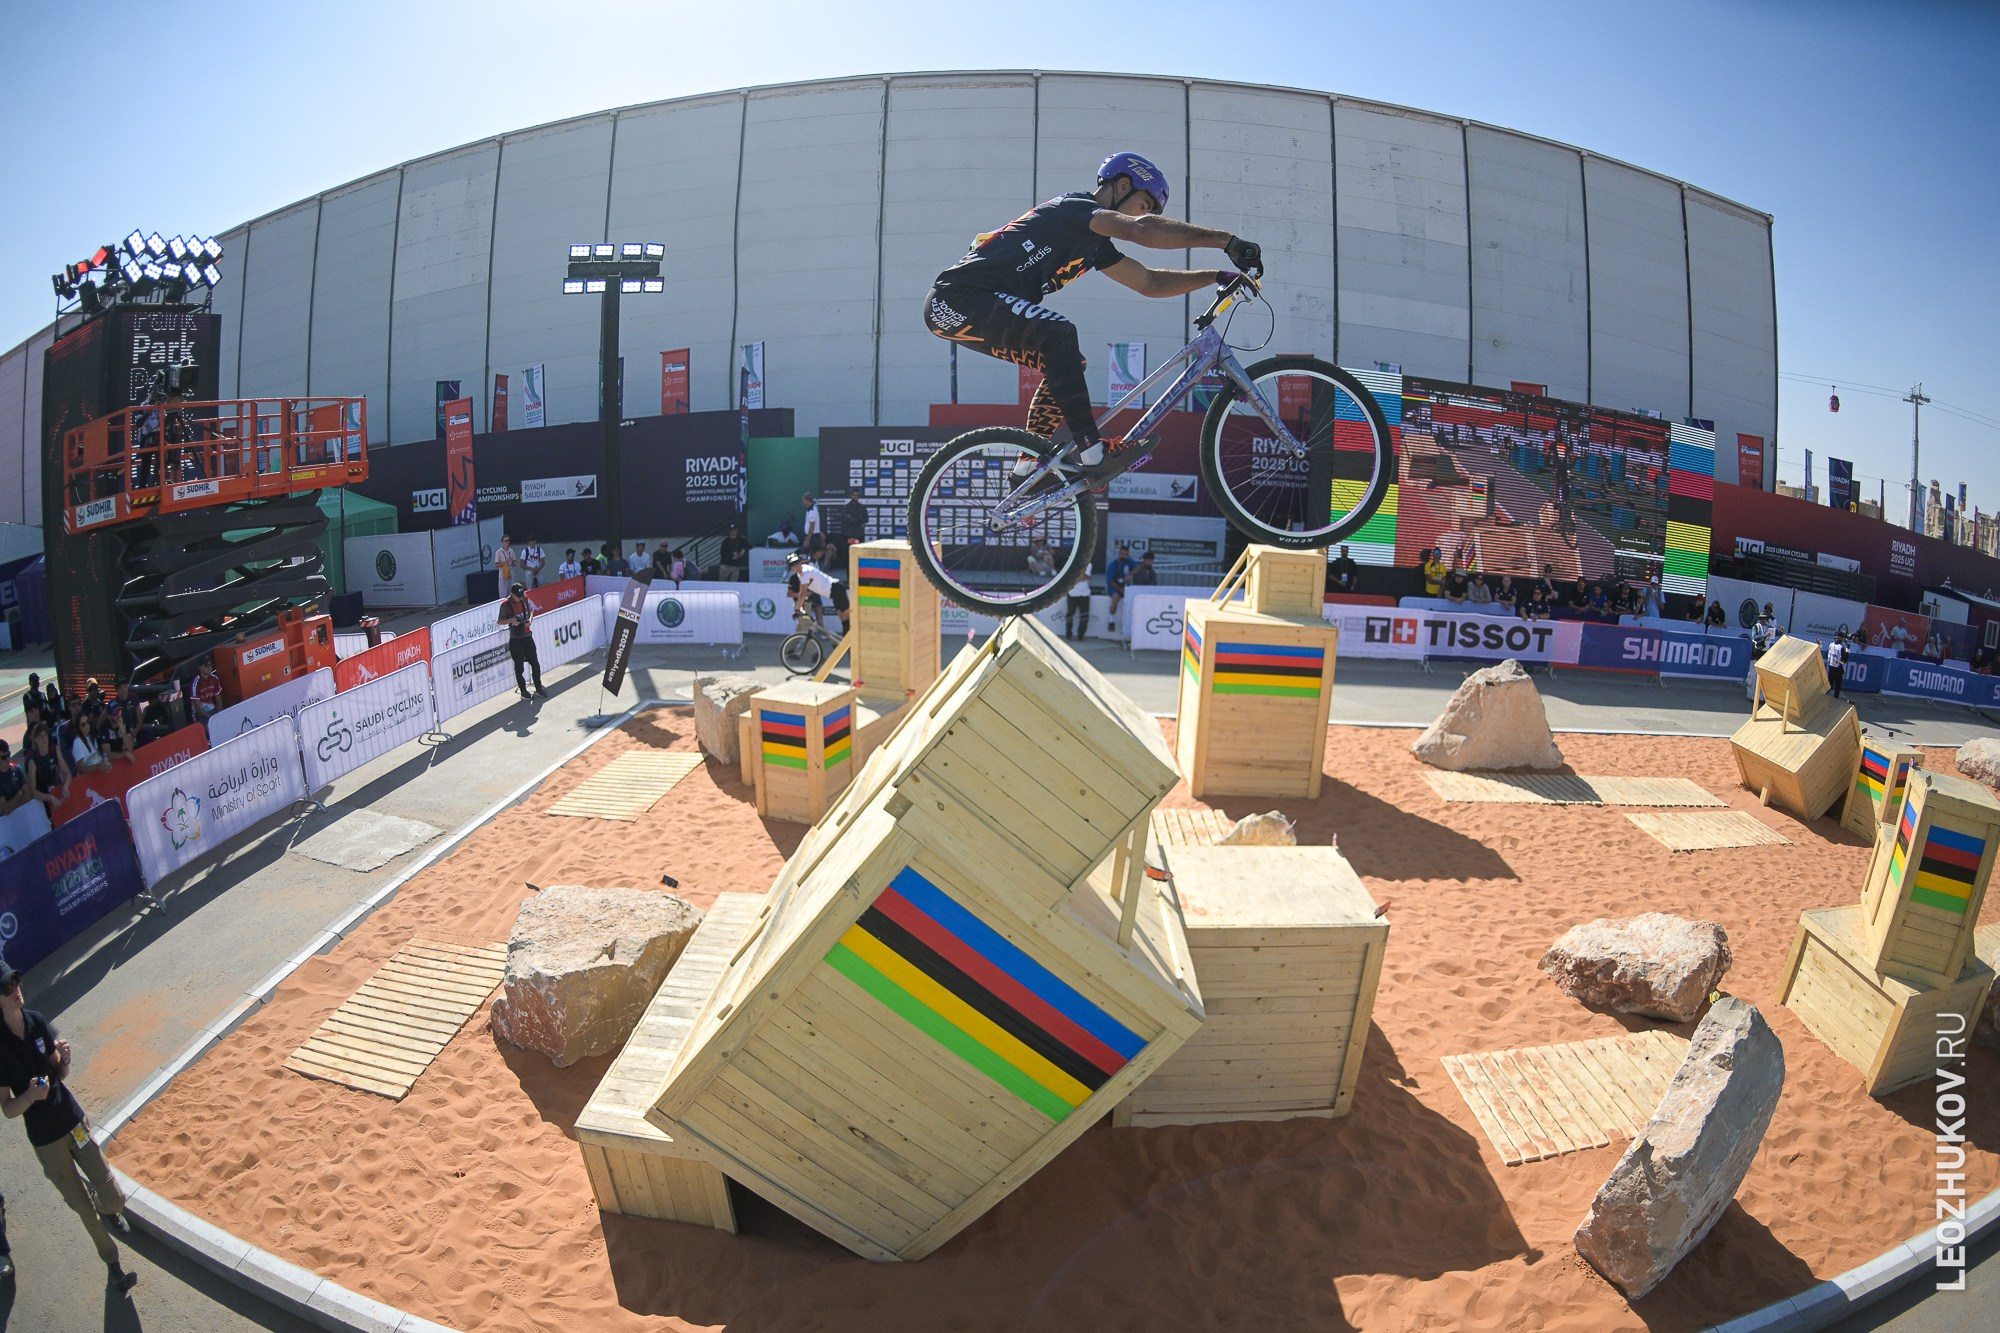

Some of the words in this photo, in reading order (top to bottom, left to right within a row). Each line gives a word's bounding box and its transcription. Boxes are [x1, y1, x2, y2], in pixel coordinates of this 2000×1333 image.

[1016, 245, 1052, 272] cofidis
[938, 300, 967, 325] SCHOOL
[930, 313, 951, 331] TRIAL
[132, 332, 196, 364] Park
[886, 443, 911, 453] UCI
[186, 483, 210, 494] SUDHIR
[686, 475, 718, 488] 2025
[720, 474, 738, 487] UC
[418, 492, 444, 508] UCI
[477, 493, 519, 503] AMPIONSHIPS
[524, 491, 543, 499] SAUDI
[543, 489, 566, 497] ARABIA
[1128, 487, 1157, 495] ARABIA
[86, 502, 112, 518] SUDHIR
[1278, 536, 1313, 544] KENDA
[1891, 540, 1916, 556] RIYADH
[1790, 550, 1809, 559] CYCLING
[1890, 554, 1905, 564] 2025
[1904, 557, 1915, 567] UCI
[557, 588, 577, 601] RIYADH
[632, 587, 641, 609] 1
[624, 611, 637, 620] UCI
[951, 610, 969, 618] UCI
[558, 620, 581, 645] UCI
[1424, 620, 1553, 653] TISSOT
[254, 643, 276, 656] SUDHIR
[397, 645, 421, 663] RIYADH
[608, 628, 630, 683] #Riyadh2025
[1622, 637, 1732, 668] SHIMANO
[455, 658, 473, 679] UCI
[1908, 669, 1965, 695] SHIMANO
[355, 711, 384, 733] SAUDI
[386, 693, 424, 717] CYCLING
[151, 748, 191, 776] RIYADH
[251, 757, 278, 780] وزارة
[208, 767, 248, 799] الرياضة
[211, 796, 245, 821] Ministry
[246, 786, 256, 803] of
[256, 774, 281, 798] Sport
[45, 834, 98, 880] RIYADH
[52, 869, 81, 897] 2025
[82, 856, 104, 878] UCI
[90, 872, 106, 885] WORLD
[59, 880, 109, 916] CHAMPIONSHIPS
